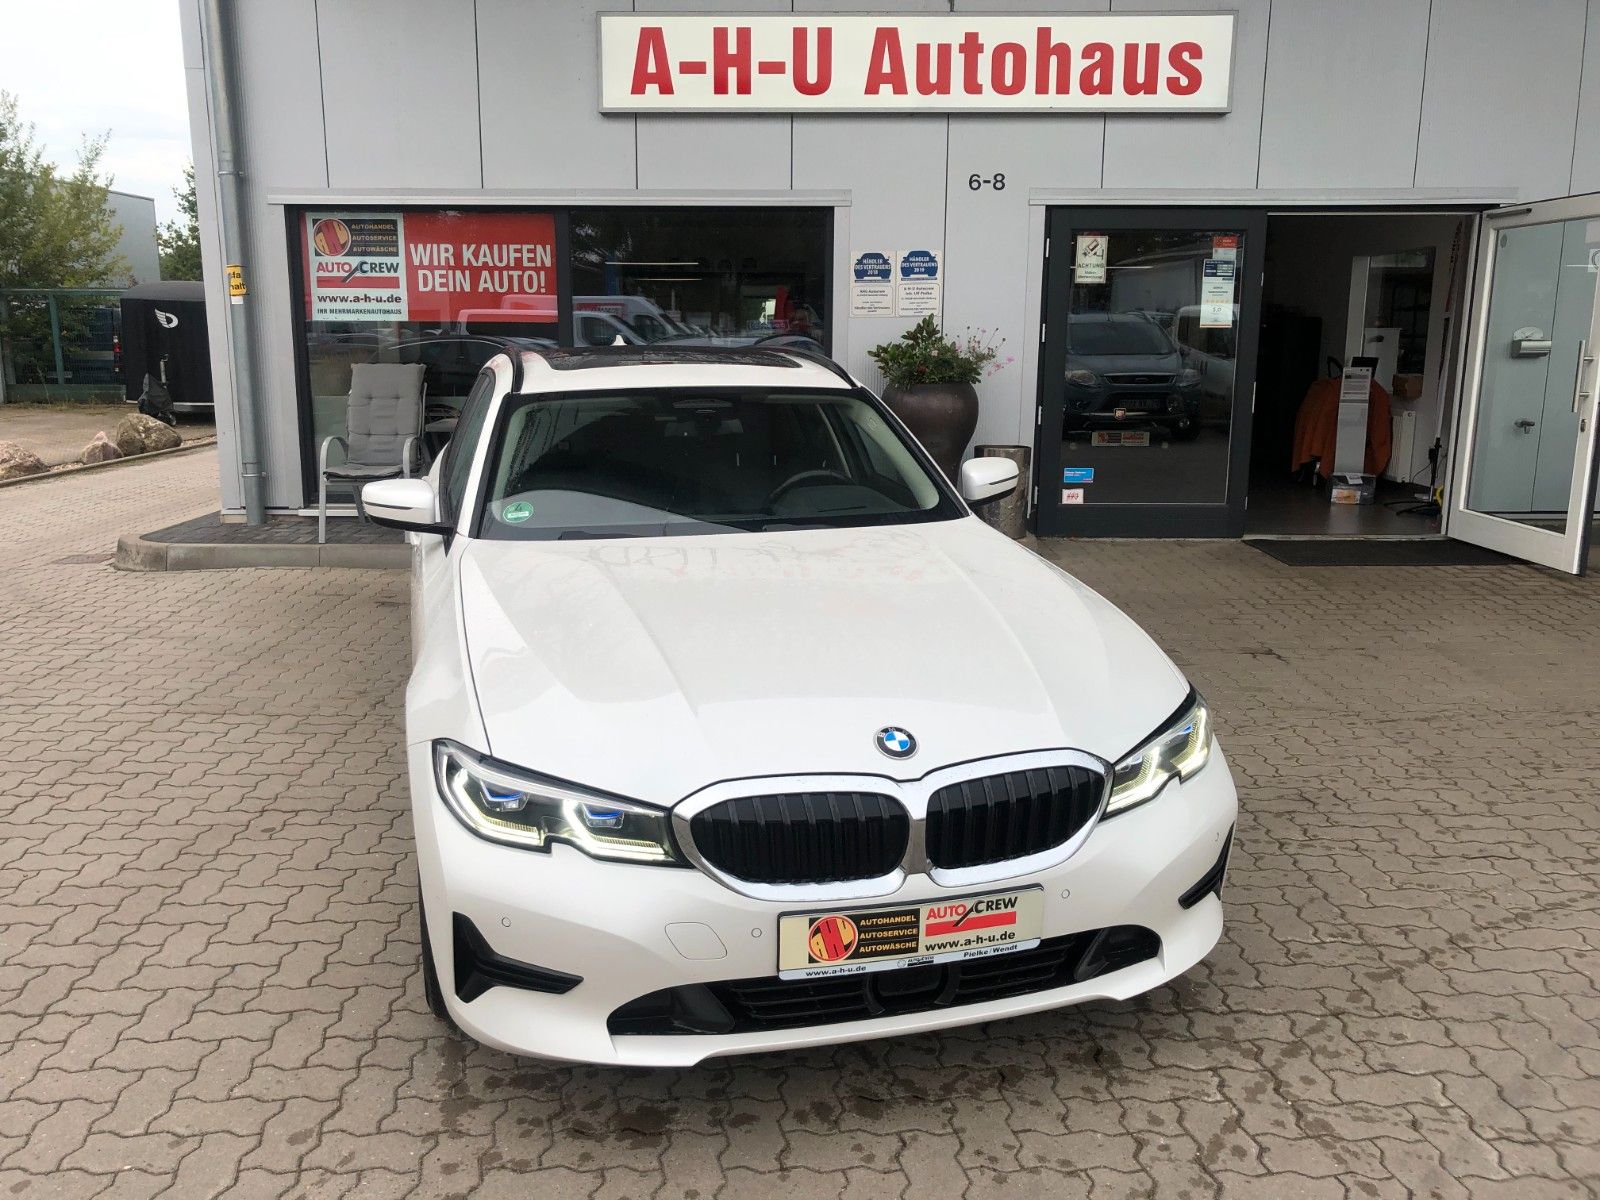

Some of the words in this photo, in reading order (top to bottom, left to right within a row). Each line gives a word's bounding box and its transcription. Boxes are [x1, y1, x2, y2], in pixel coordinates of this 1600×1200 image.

[630, 26, 833, 96] A-H-U
[864, 26, 1203, 96] Autohaus
[968, 173, 1006, 191] 6-8
[351, 223, 396, 231] AUTOHANDEL
[352, 234, 398, 242] AUTOSERVICE
[352, 245, 398, 253] AUTOWÄSCHE
[409, 243, 456, 267] WIR
[462, 244, 553, 268] KAUFEN
[316, 261, 353, 273] AUTO
[358, 260, 400, 274] CREW
[417, 269, 472, 292] DEIN
[477, 270, 547, 293] AUTO!
[317, 294, 403, 304] www.a-h-u.de
[329, 308, 402, 316] MEHRMARKENAUTOHAUS
[926, 903, 967, 921] AUTO
[972, 896, 1018, 914] CREW
[860, 914, 917, 926] AUTOHANDEL
[860, 927, 919, 939] AUTOSERVICE
[859, 941, 918, 953] AUTOWÄSCHE
[925, 930, 1016, 952] www.a-h-u.de
[805, 965, 867, 977] www.a-h-u.de
